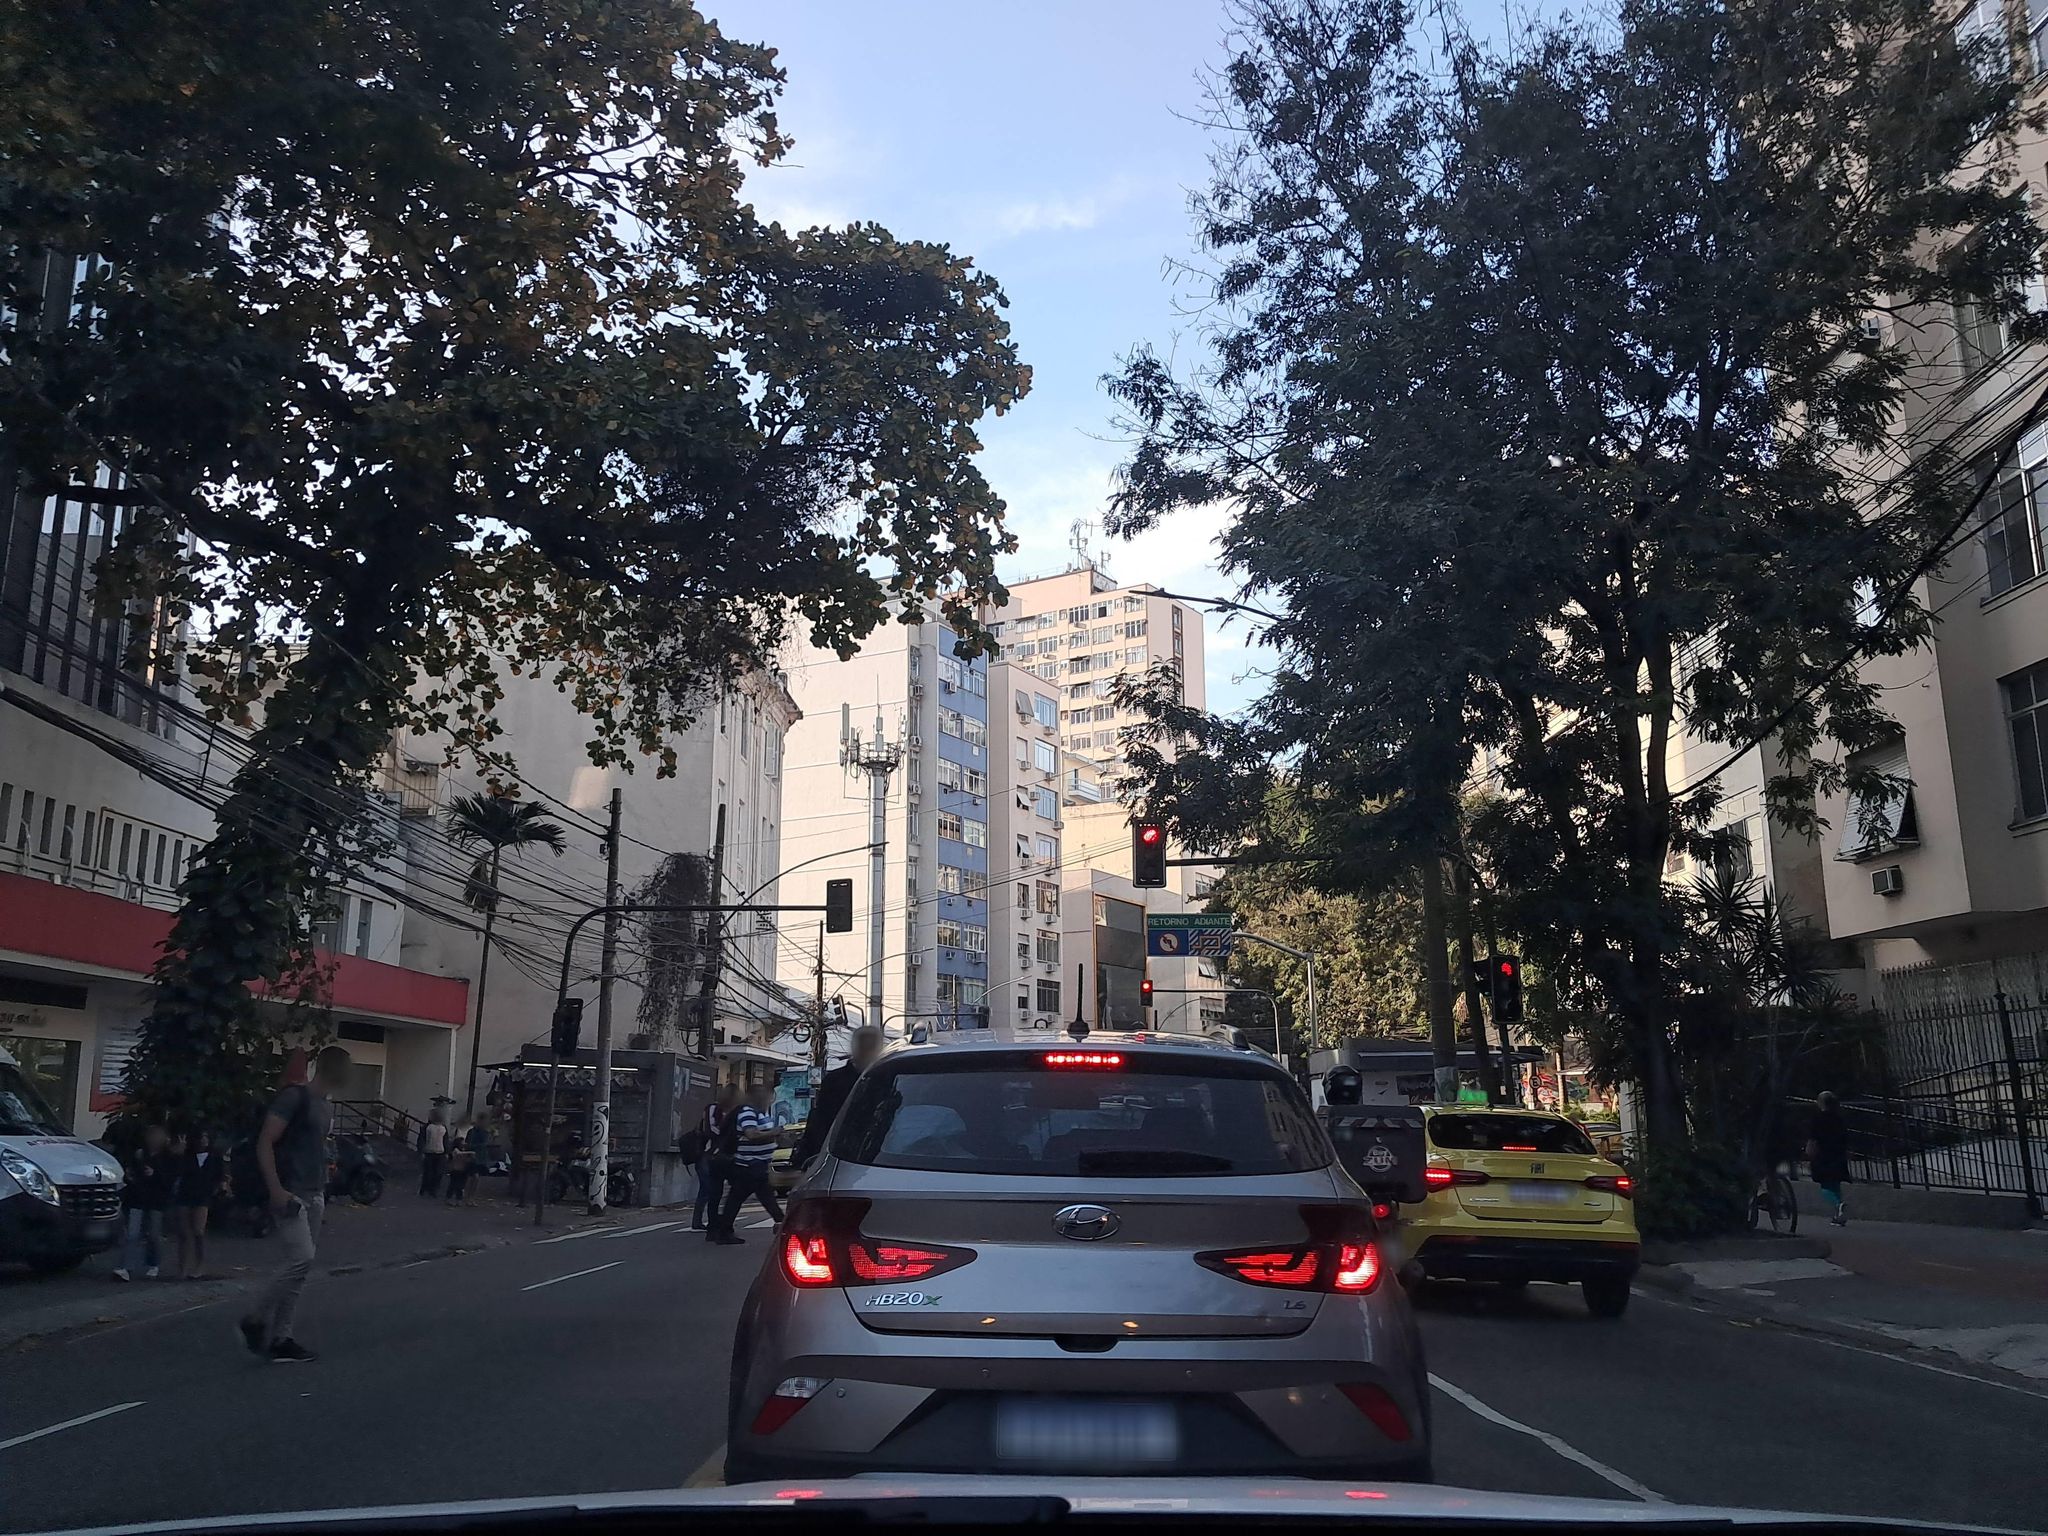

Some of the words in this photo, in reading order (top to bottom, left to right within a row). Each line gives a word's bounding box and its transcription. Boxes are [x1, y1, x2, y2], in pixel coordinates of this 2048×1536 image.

[1147, 917, 1189, 926] RETORNO
[1194, 917, 1231, 926] ADIANTE
[1530, 1162, 1545, 1174] FIAT
[865, 1291, 943, 1306] HB20X
